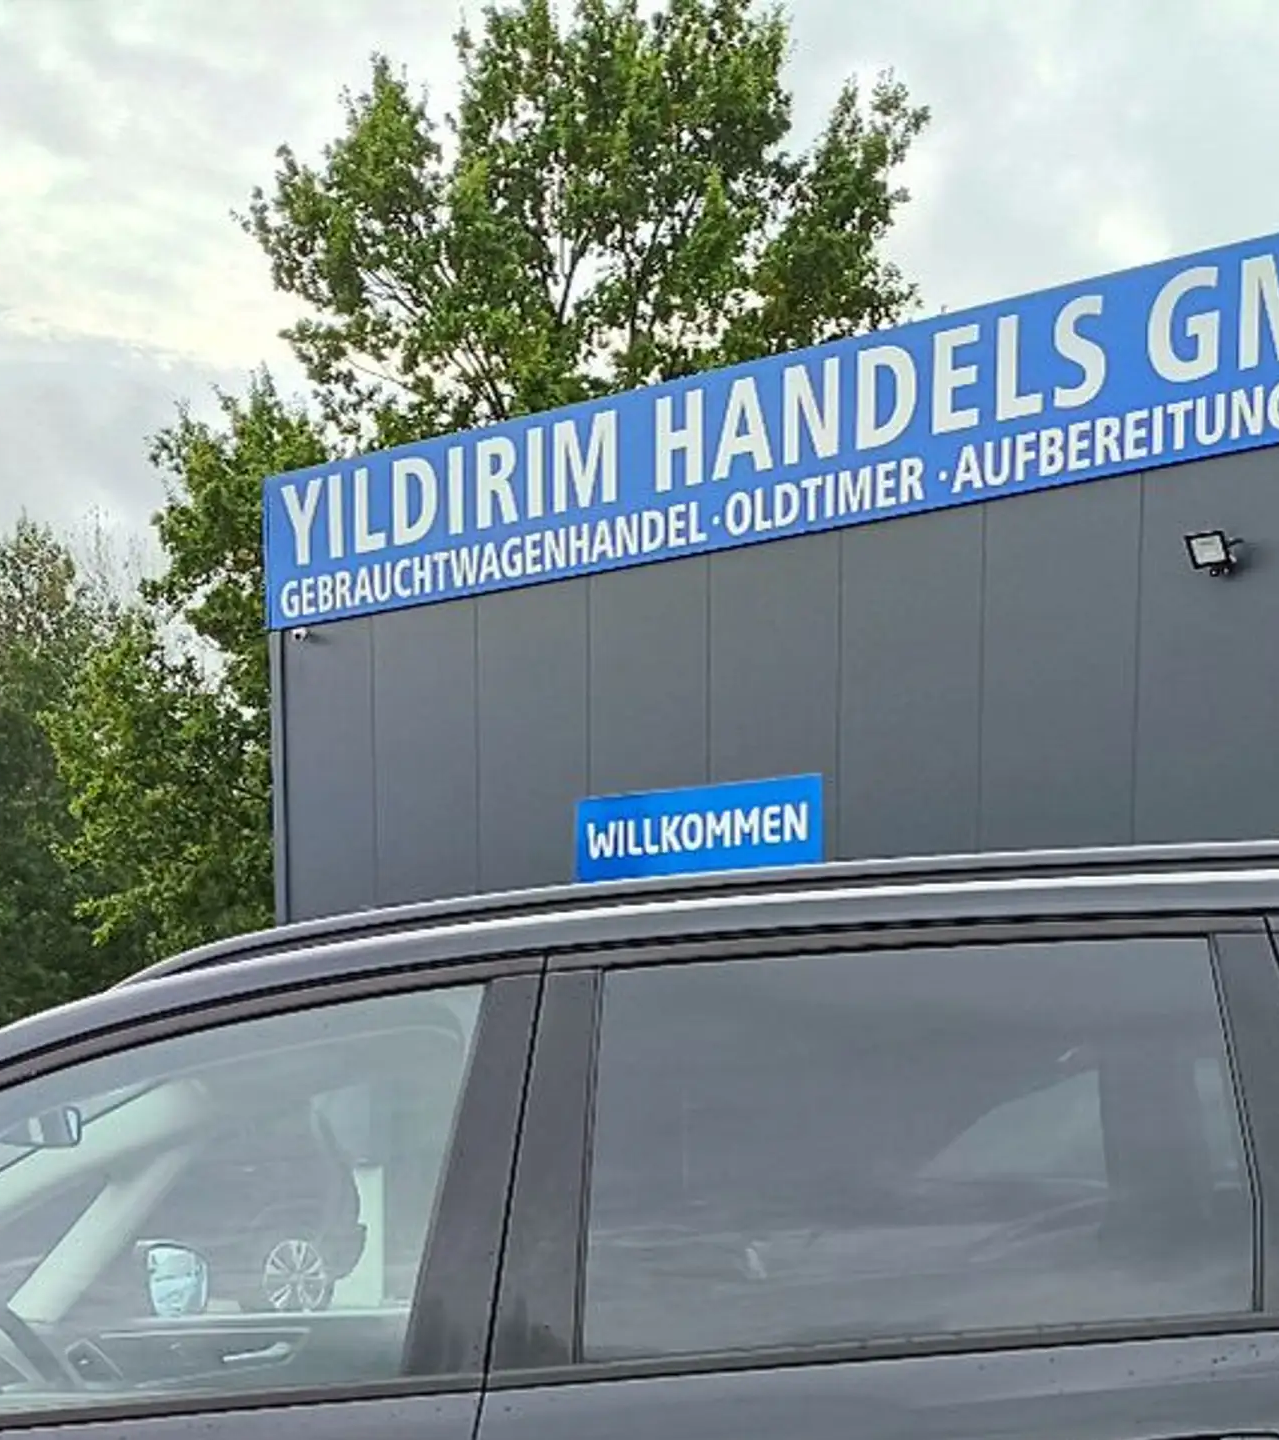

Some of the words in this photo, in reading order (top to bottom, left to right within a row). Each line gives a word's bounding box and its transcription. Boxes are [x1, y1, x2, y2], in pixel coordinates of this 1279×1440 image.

[280, 410, 618, 566] YILDIRIM
[655, 296, 1107, 493] HANDELS
[280, 501, 707, 619] GEBRAUCHTWAGENHANDEL
[725, 457, 924, 537] OLDTIMER
[587, 803, 809, 859] WILLKOMMEN
